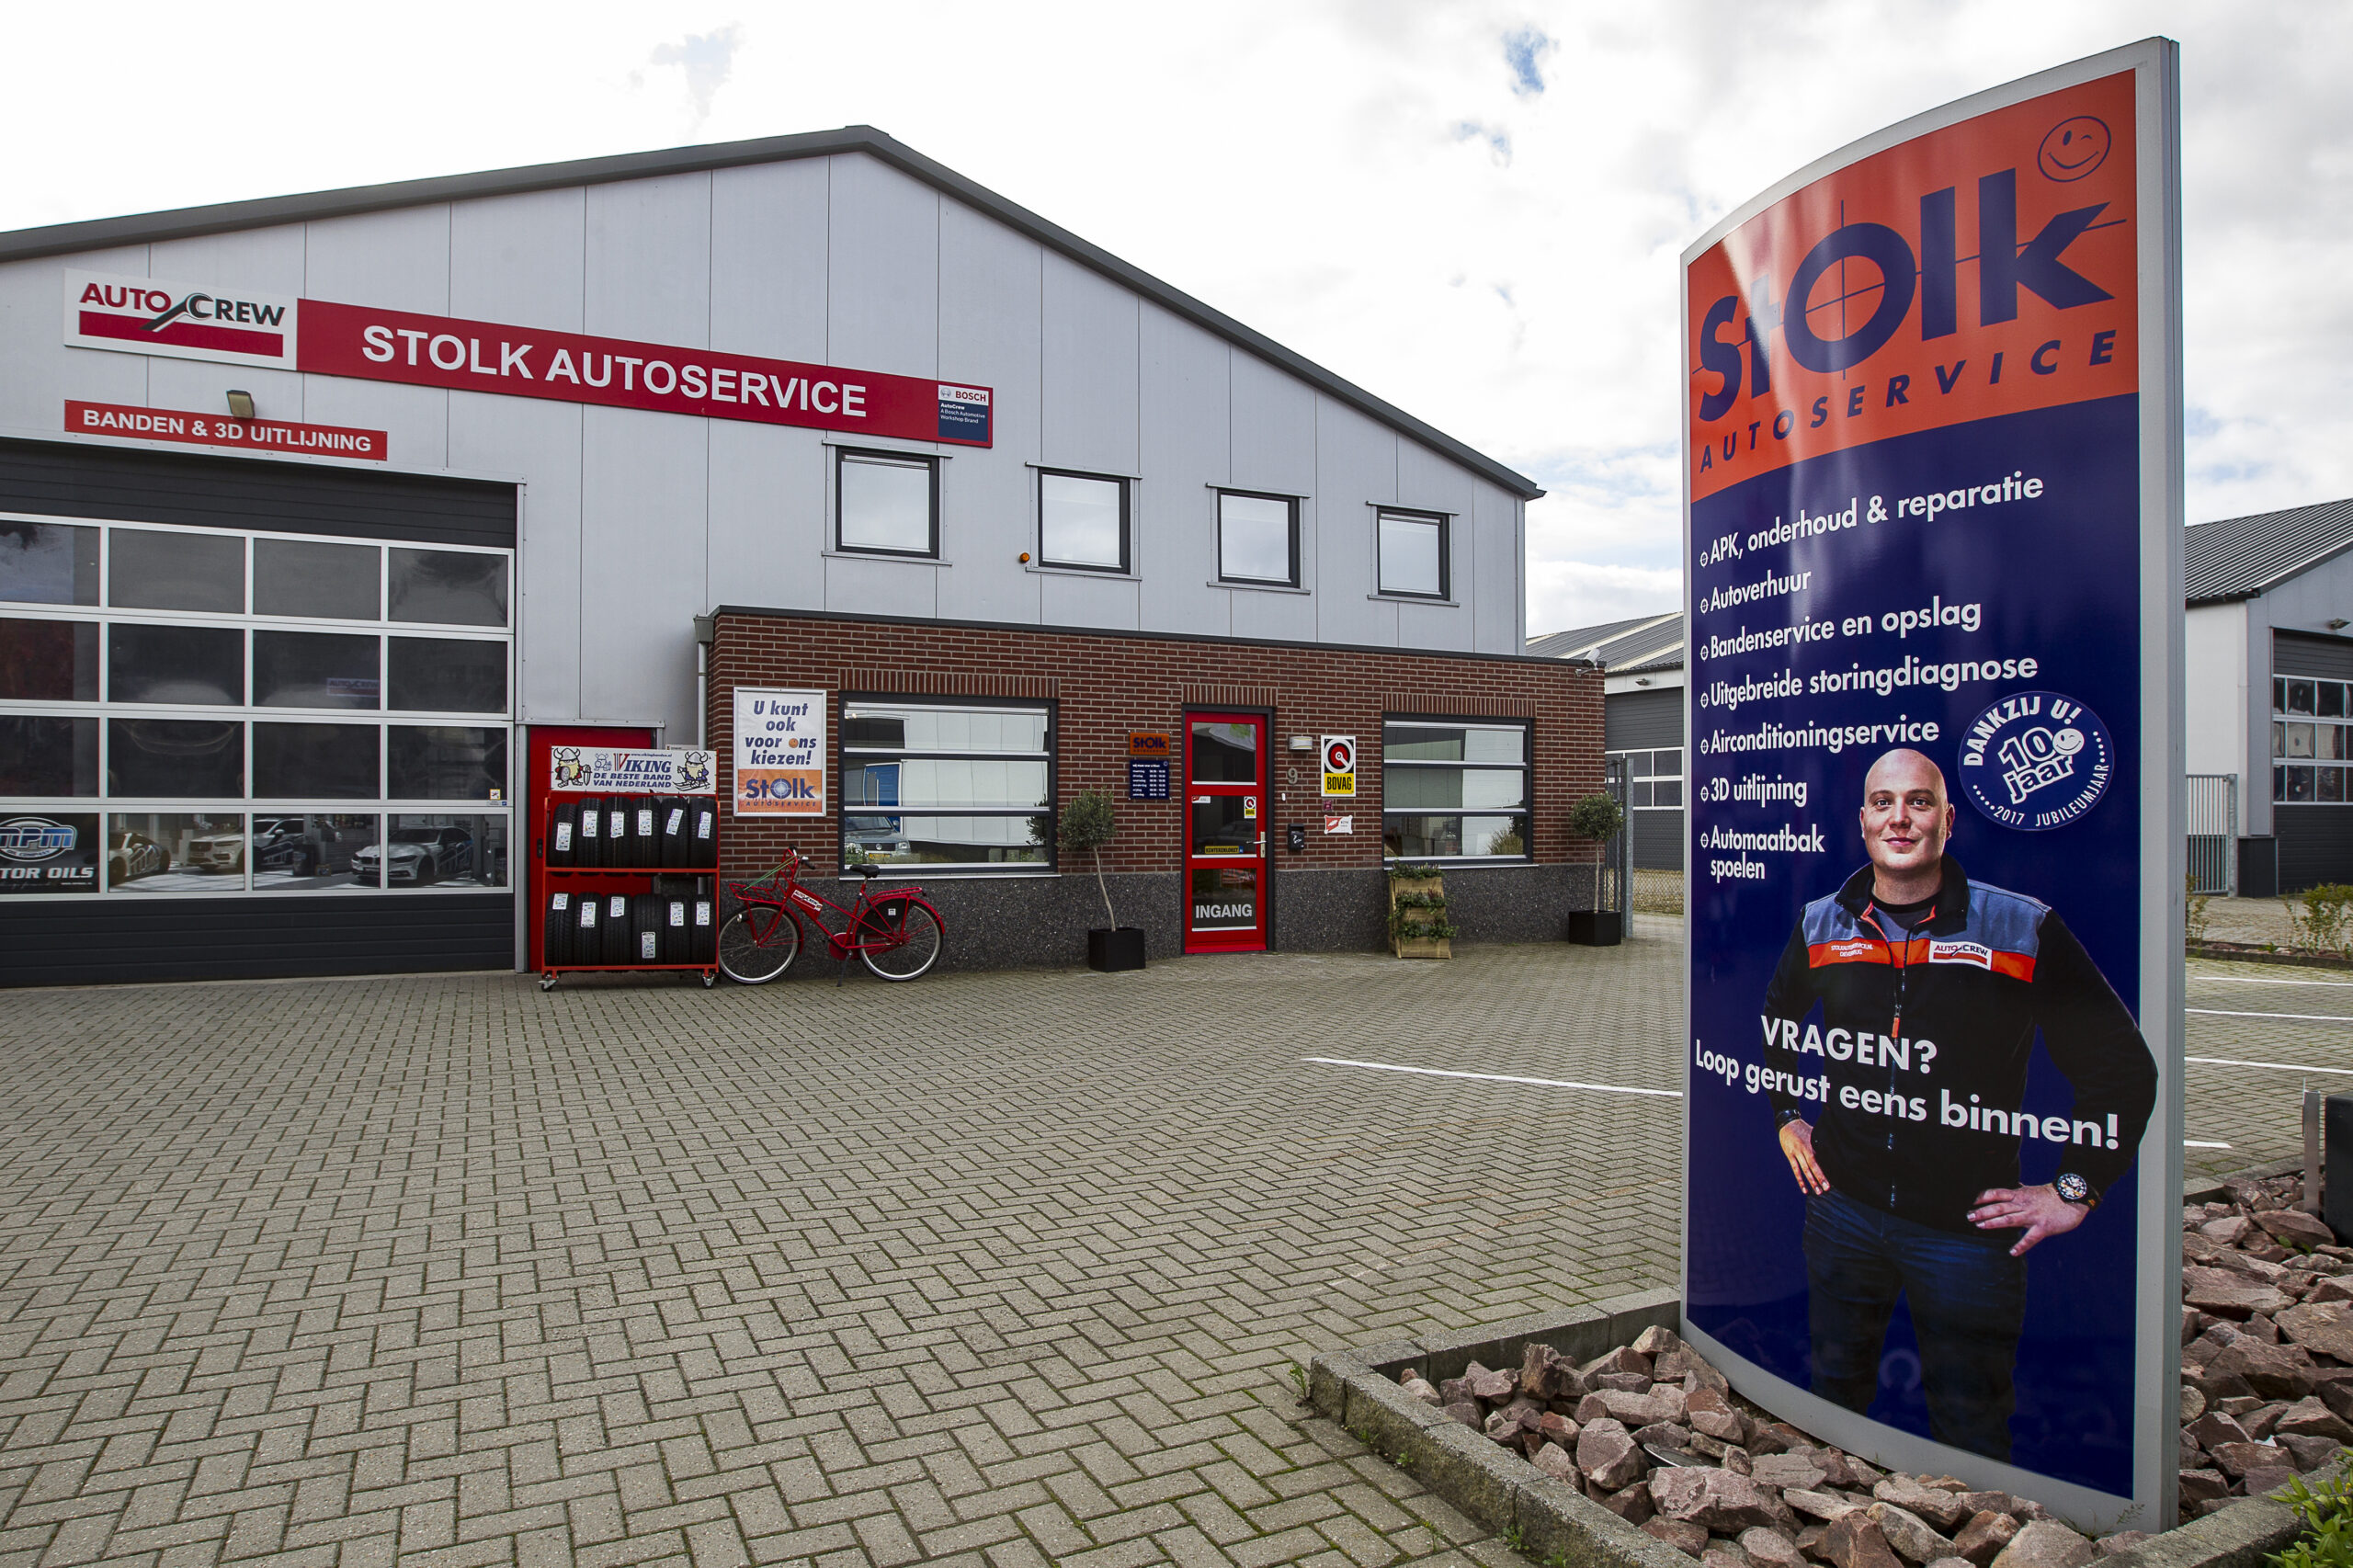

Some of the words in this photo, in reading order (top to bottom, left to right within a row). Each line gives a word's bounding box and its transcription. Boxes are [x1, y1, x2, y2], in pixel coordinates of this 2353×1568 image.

[80, 282, 172, 313] AUTO
[187, 292, 286, 327] CREW
[362, 324, 534, 379] STOLK
[544, 348, 867, 418] AUTOSERVICE
[955, 391, 986, 402] BOSCH
[1699, 329, 2117, 473] AUTOSERVICE
[83, 409, 185, 435] BANDEN
[191, 420, 209, 437] &
[214, 422, 244, 440] 3D
[250, 426, 371, 451] UITLIJNING
[1710, 531, 1744, 565] APK,
[1747, 497, 1858, 551] onderhoud
[1867, 494, 1889, 525] &
[1897, 471, 2044, 522] reparatie
[1710, 569, 1812, 612] Autoverhuur
[1711, 616, 1835, 659] Bandenservice
[1842, 615, 1872, 637] en
[1881, 596, 1981, 639] opslag
[1711, 667, 1802, 711] Uitgebreide
[1809, 655, 2038, 696] storingdiagnose
[754, 700, 765, 715] U
[770, 699, 809, 716] kunt
[766, 716, 796, 732] ook
[745, 737, 782, 748] voor
[1711, 714, 1939, 754] Airconditioningservice
[1963, 696, 2040, 767] DANKZIJ
[2050, 699, 2082, 725] U!
[613, 753, 672, 773] VIKING
[750, 749, 812, 765] kiezen!
[1288, 767, 1298, 785] 9
[1326, 777, 1352, 790] BOVAG
[1711, 778, 1730, 801] 3D
[1733, 773, 1807, 808] uitlijning
[2002, 755, 2075, 805] jaar
[1993, 805, 2025, 826] 2017
[2035, 764, 2109, 827] JUBILEUMJAAR
[1710, 824, 1825, 853] Automaatbak
[47, 867, 95, 879] OILS
[1711, 852, 1766, 883] spoelen
[1195, 903, 1253, 919] INGANG
[1962, 944, 1988, 956] CREW
[1760, 1014, 1938, 1074] VRAGEN?
[1695, 1039, 1740, 1085] Loop
[1745, 1062, 1831, 1103] gerust
[1838, 1084, 1927, 1121] eens
[1940, 1088, 2120, 1149] binnen!
